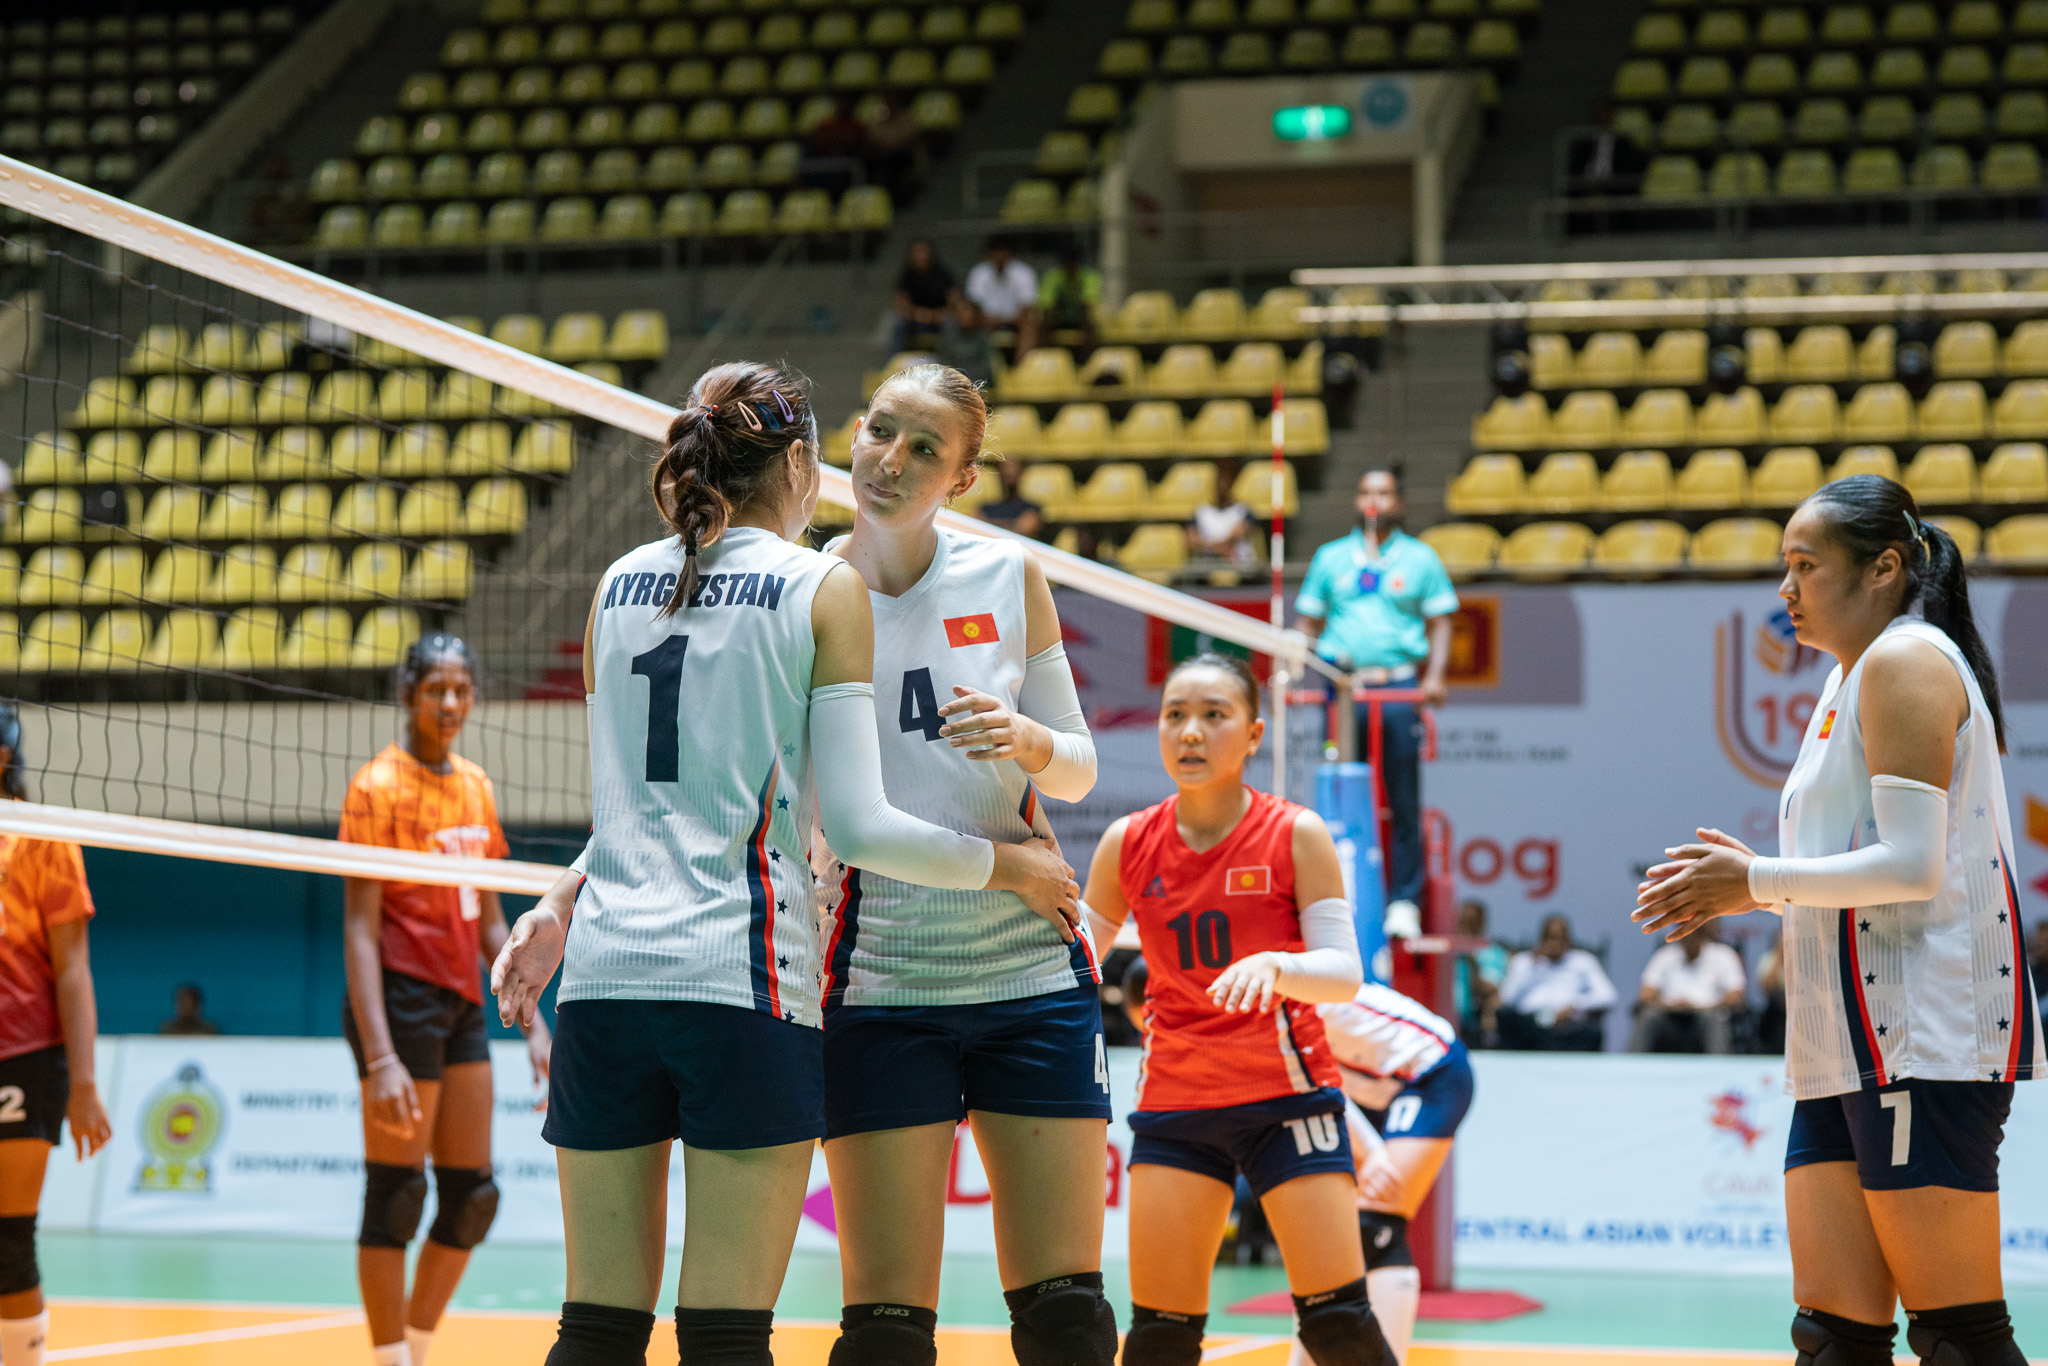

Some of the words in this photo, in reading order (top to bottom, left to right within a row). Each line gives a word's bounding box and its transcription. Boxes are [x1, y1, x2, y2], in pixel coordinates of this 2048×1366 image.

[604, 572, 786, 612] KYRGZSTAN
[631, 634, 690, 783] 1
[898, 666, 947, 743] 4
[1166, 909, 1233, 970] 10
[1094, 1032, 1110, 1095] 4
[1454, 1216, 1568, 1243] ENTRAL
[1678, 1222, 1786, 1249] VOLLE
